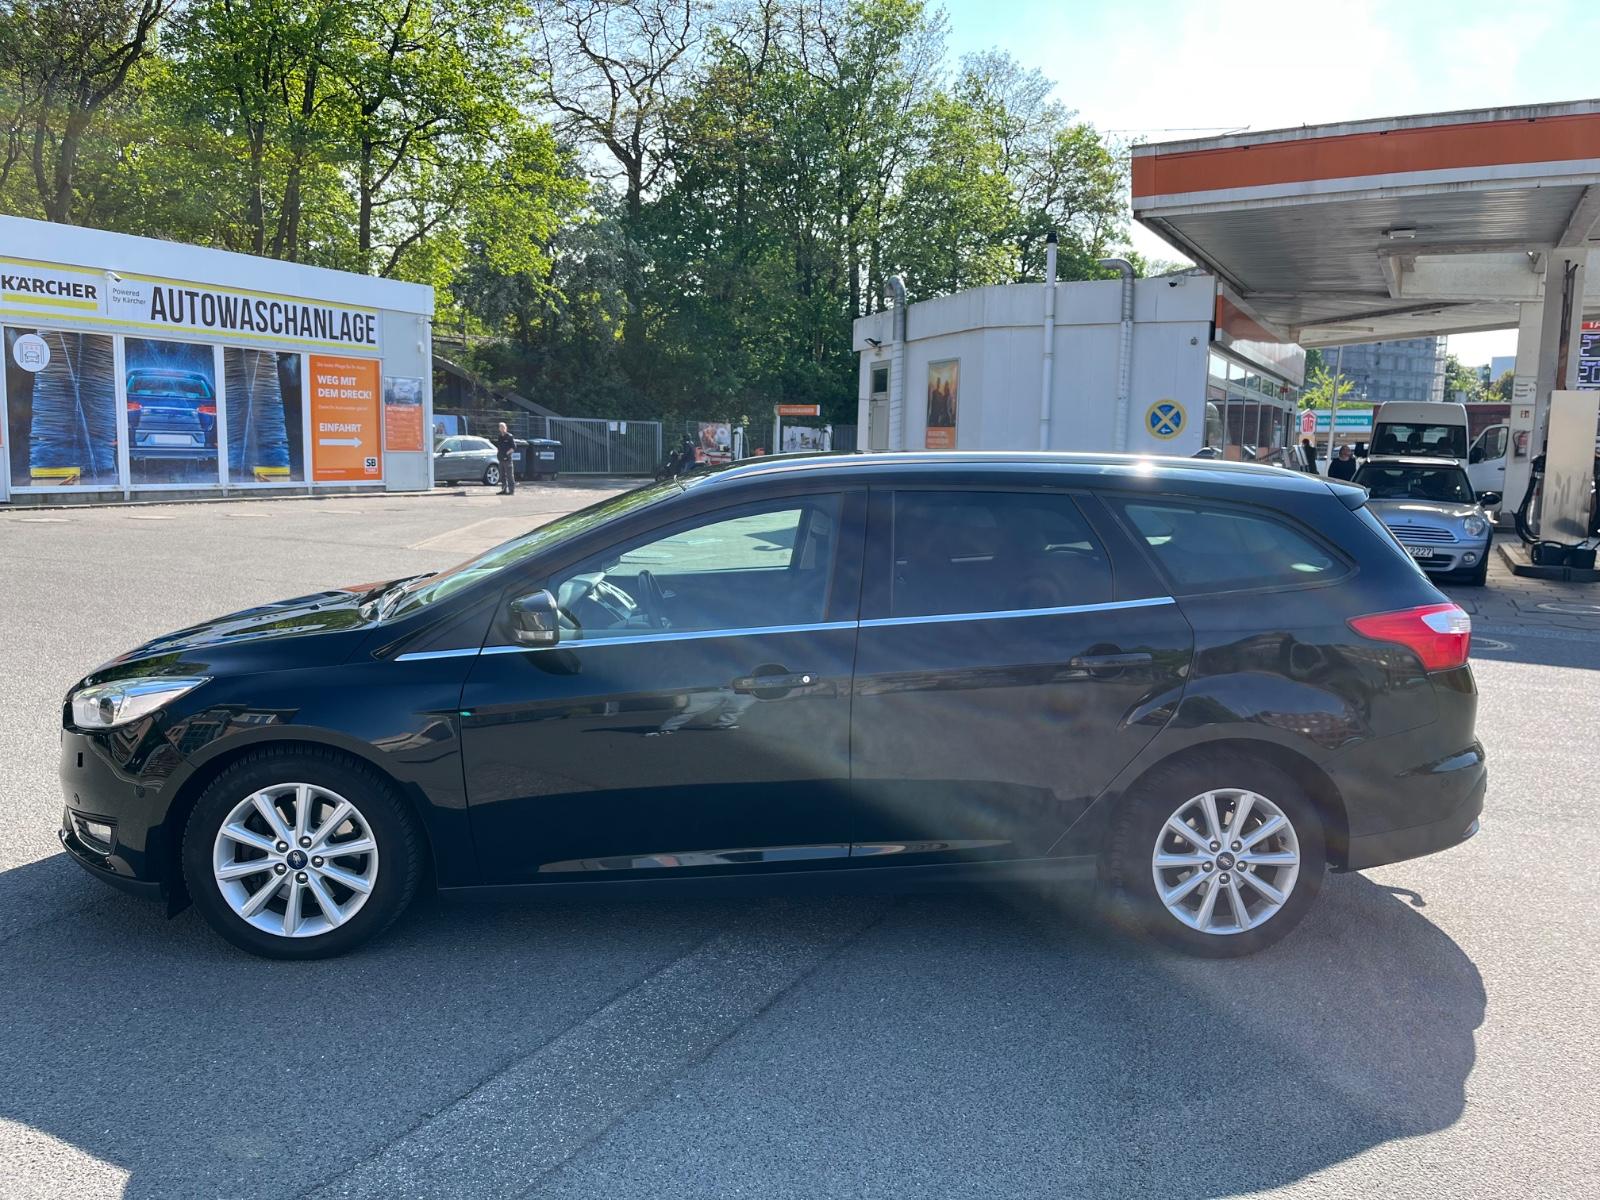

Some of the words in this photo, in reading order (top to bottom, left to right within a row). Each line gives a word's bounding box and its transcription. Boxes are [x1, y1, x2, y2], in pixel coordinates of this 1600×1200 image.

[1, 274, 98, 299] KÄRCHER
[112, 287, 140, 297] Powered
[112, 296, 121, 304] by
[122, 297, 146, 305] Kärcher
[150, 286, 376, 344] AUTOWASCHANLAGE
[317, 375, 339, 385] WEG
[340, 376, 357, 386] MIT
[318, 388, 339, 399] DEM
[340, 389, 372, 400] DRECK!
[319, 422, 362, 433] EINFAHRT
[366, 458, 377, 467] SB
